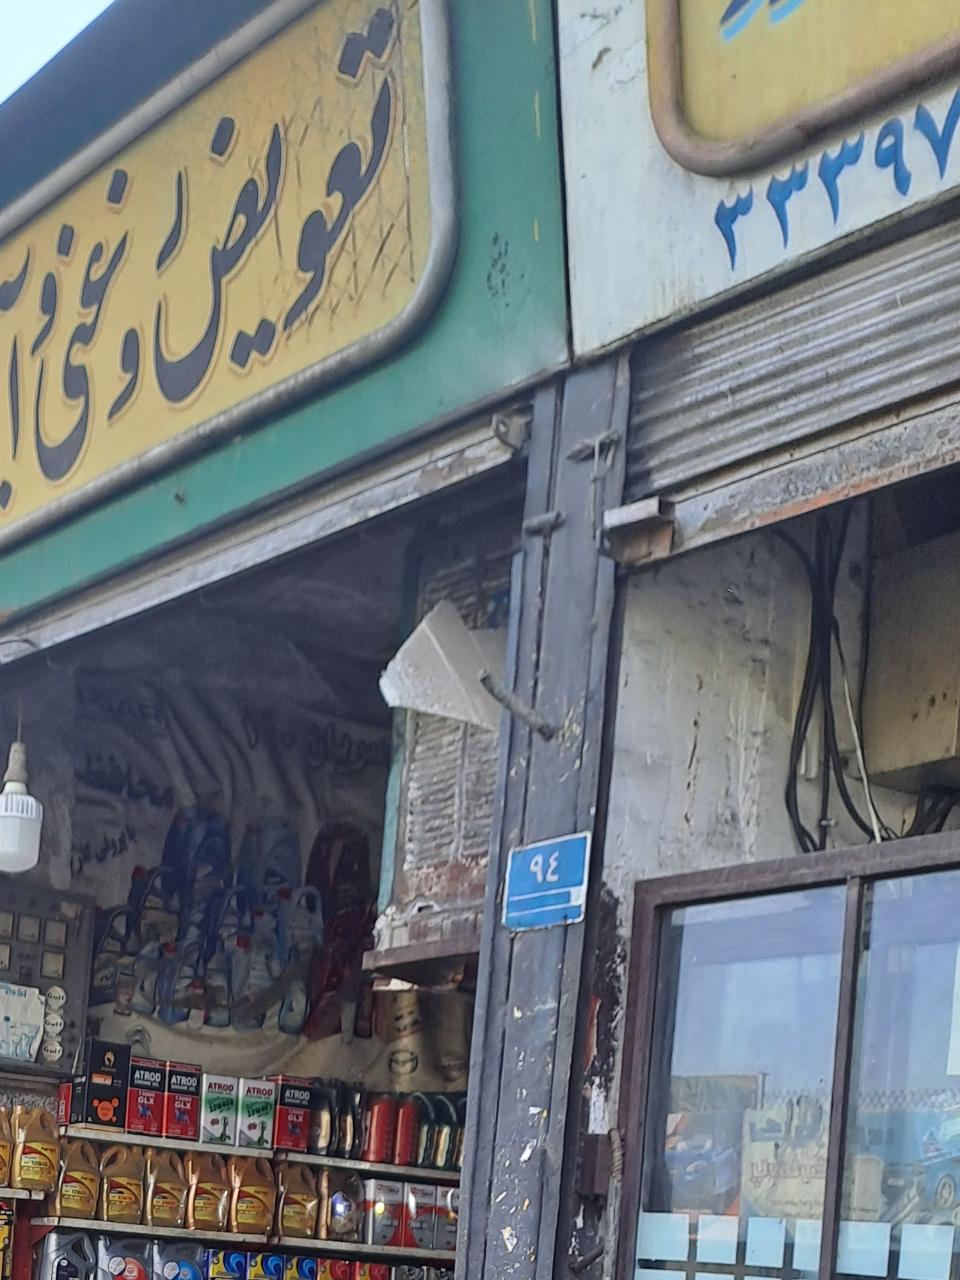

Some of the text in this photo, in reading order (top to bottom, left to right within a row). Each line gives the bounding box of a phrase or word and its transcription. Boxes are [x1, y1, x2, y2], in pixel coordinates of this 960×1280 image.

[155, 8, 394, 402] تعویض
[134, 1069, 161, 1082] ATROD
[171, 1074, 198, 1087] ATROD
[207, 1081, 234, 1092] ATROD
[246, 1086, 273, 1097] ATROD
[138, 1096, 155, 1104] GLX
[284, 1088, 311, 1100] ATROD
